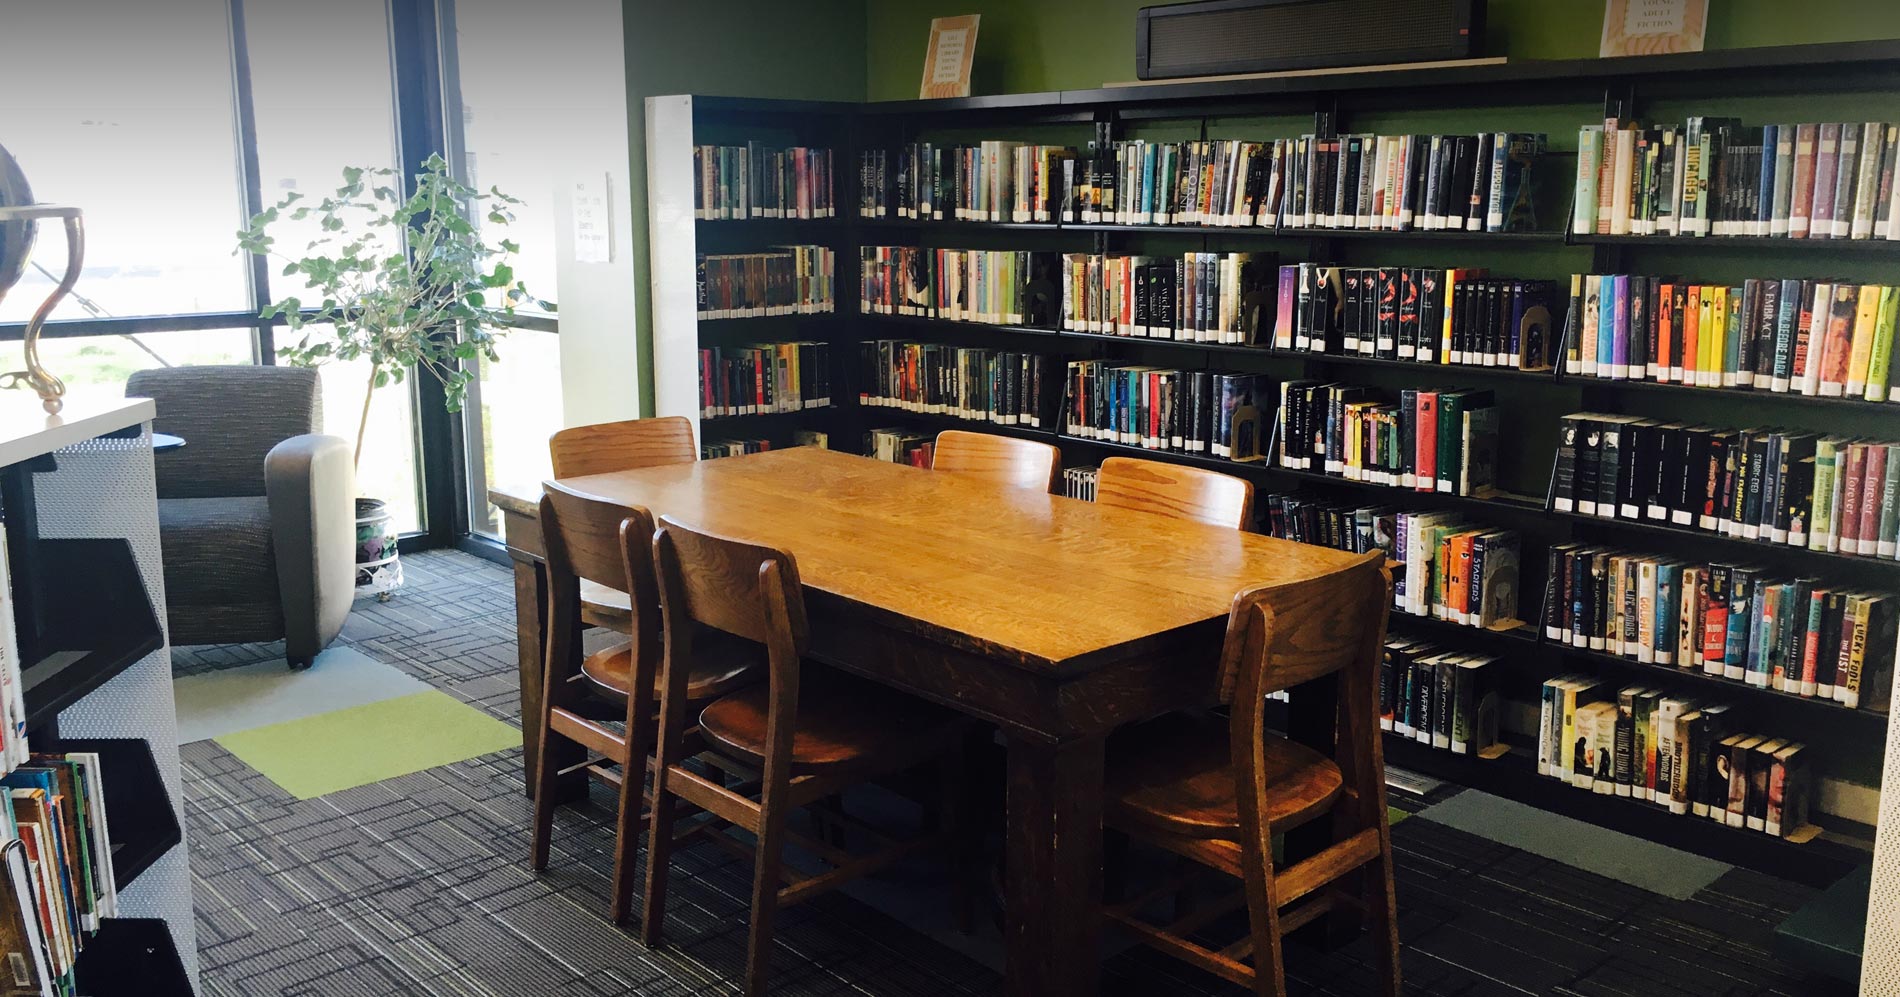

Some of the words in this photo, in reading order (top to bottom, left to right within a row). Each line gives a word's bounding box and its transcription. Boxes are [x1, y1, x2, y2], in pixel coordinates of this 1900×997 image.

[1637, 20, 1673, 28] FICTION
[1642, 9, 1671, 17] ADULT
[1187, 167, 1199, 208] TORN
[1684, 145, 1701, 202] UNCAGED
[1138, 288, 1147, 320] wicked
[1161, 287, 1171, 322] wicked
[1761, 293, 1775, 341] EMBRACE
[1777, 323, 1791, 352] BEFORE
[1801, 311, 1813, 333] CODE
[1774, 354, 1788, 375] DARK
[1793, 345, 1808, 377] SILENCE
[1750, 453, 1762, 494] STARRY-EYED
[1846, 476, 1859, 515] forever
[1865, 476, 1878, 516] forever
[1885, 479, 1898, 513] linger
[1471, 557, 1481, 602] STARTERS
[1625, 589, 1635, 606] LIFE
[1640, 597, 1650, 629] GOLDEN
[1625, 613, 1635, 637] MARS
[1640, 631, 1650, 648] BOY
[1852, 624, 1865, 654] LUCKY
[1838, 651, 1849, 673] LIST
[1848, 660, 1860, 691] FOOLS
[1660, 737, 1671, 782] AFTERWORLDS
[1671, 741, 1683, 800] BROTHERHOOD
